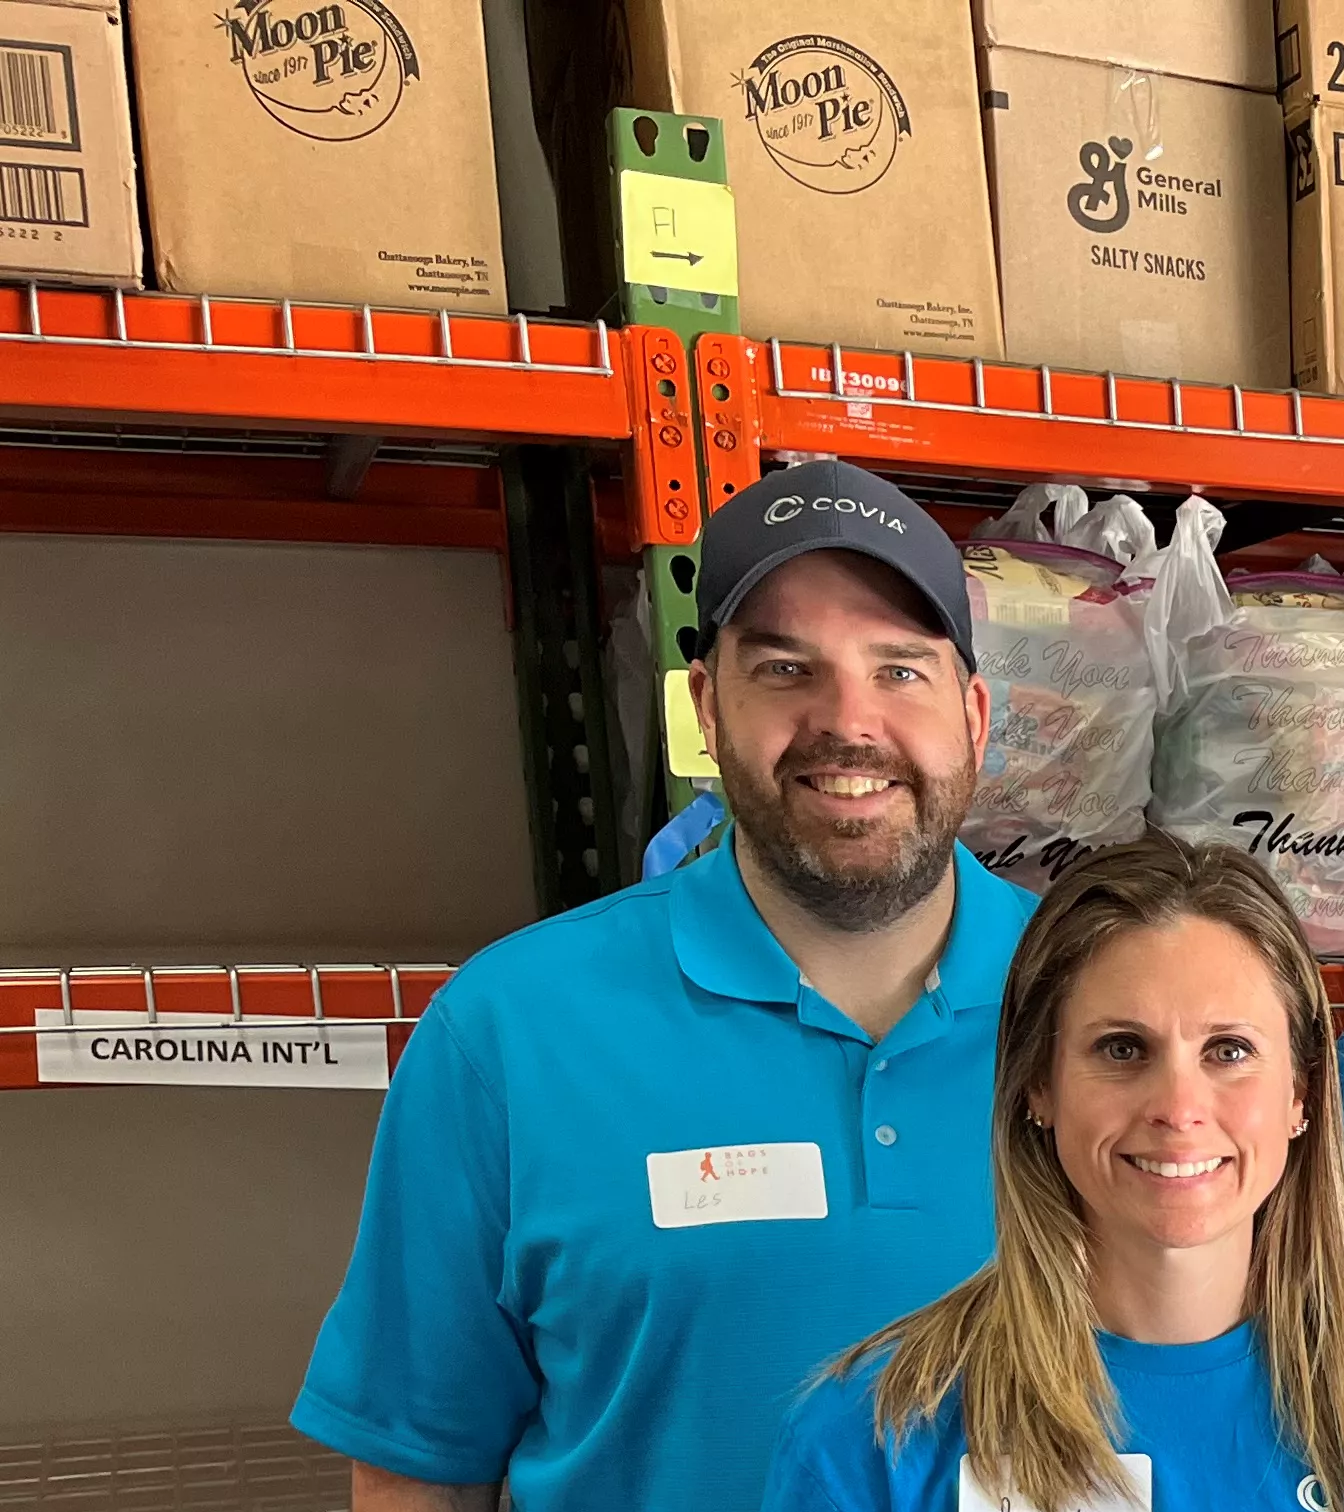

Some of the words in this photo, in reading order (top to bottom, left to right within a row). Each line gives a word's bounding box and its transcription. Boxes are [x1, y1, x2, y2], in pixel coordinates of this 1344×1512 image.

[230, 4, 347, 63] Moon
[253, 68, 281, 84] since
[284, 56, 309, 77] 1917
[310, 34, 377, 86] Pie
[745, 65, 849, 119] Moon
[766, 125, 789, 140] since
[792, 113, 814, 133] 1917
[816, 93, 872, 141] Pie
[1136, 167, 1222, 197] General
[1138, 190, 1187, 215] Mills
[1091, 245, 1139, 271] SALTY
[1144, 253, 1206, 281] SNACKS
[812, 497, 904, 535] COVIA
[90, 1037, 251, 1063] CAROLINA
[262, 1041, 339, 1065] INT'L
[724, 1149, 767, 1160] BAGS
[727, 1166, 769, 1177] HOPE
[684, 1190, 722, 1210] Les
